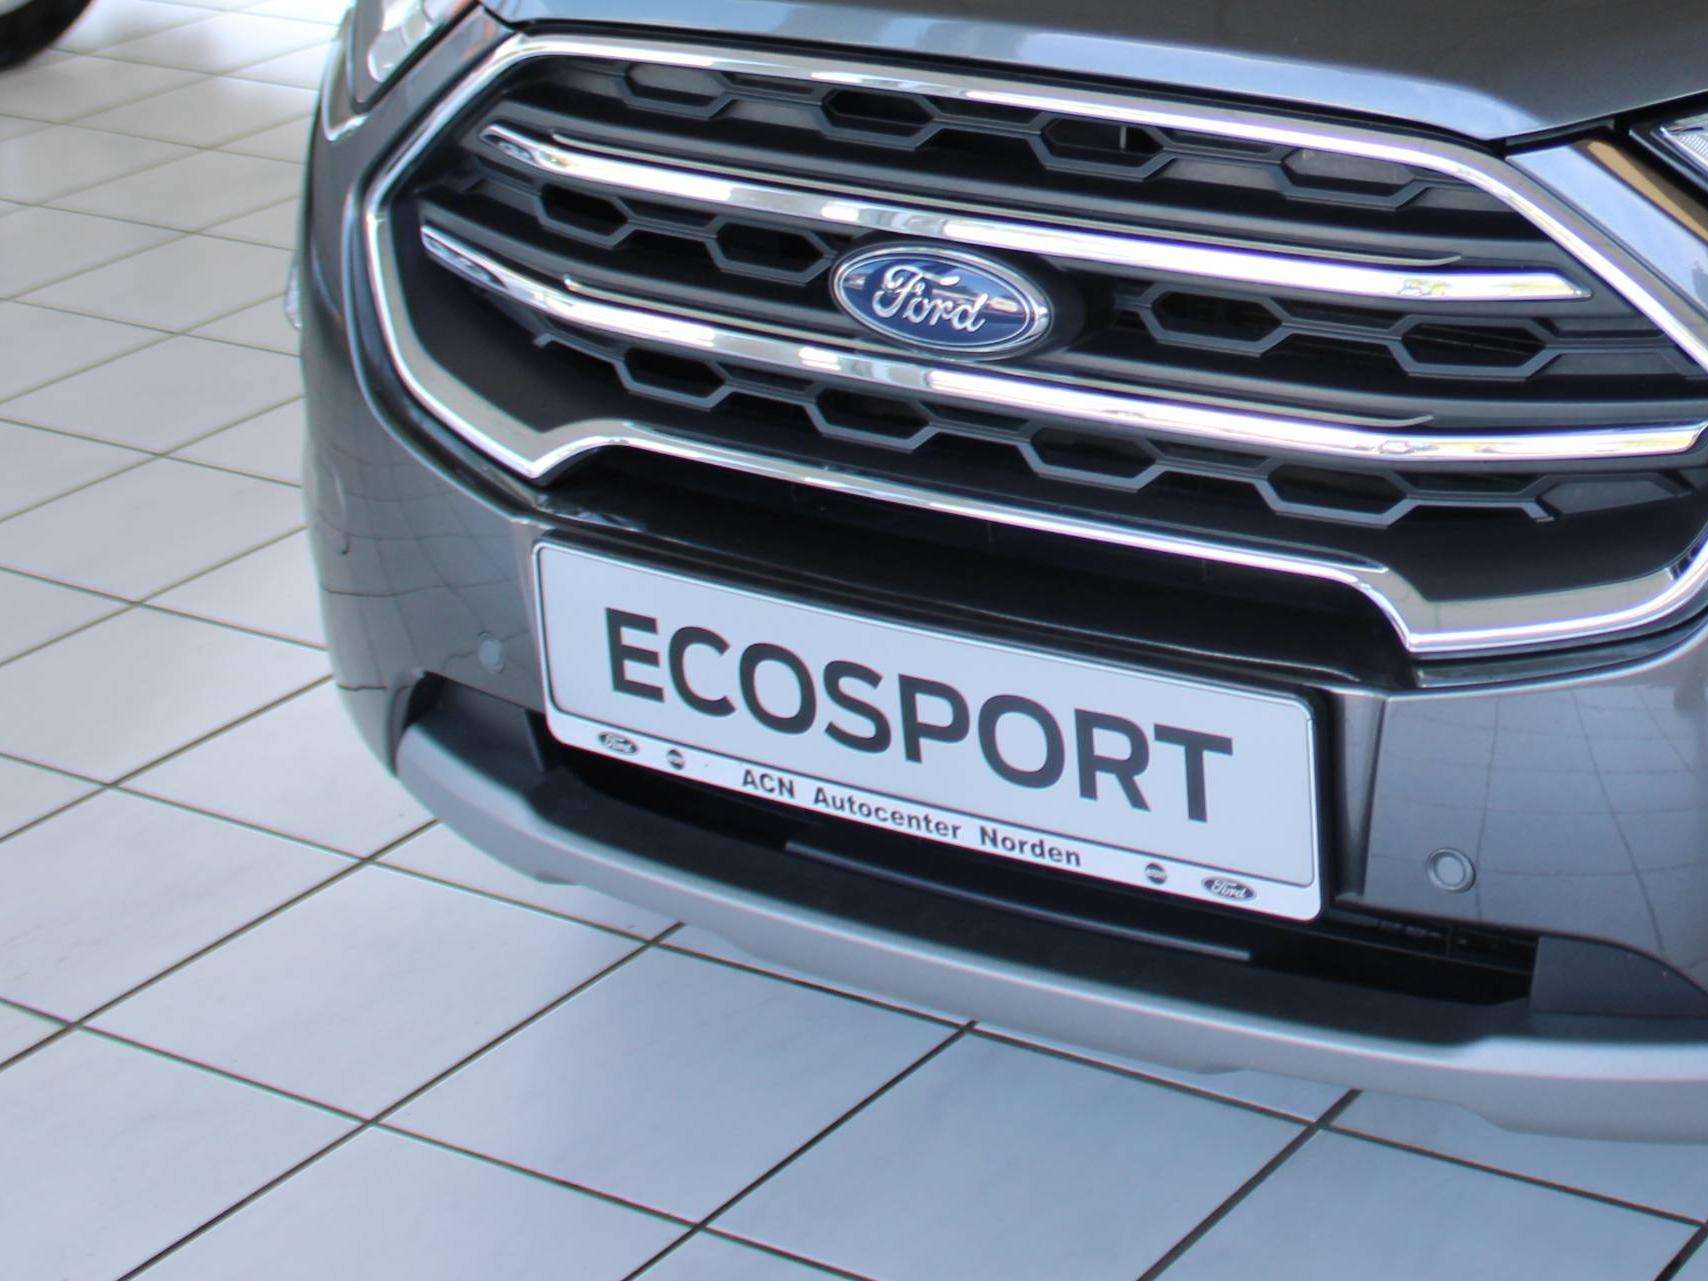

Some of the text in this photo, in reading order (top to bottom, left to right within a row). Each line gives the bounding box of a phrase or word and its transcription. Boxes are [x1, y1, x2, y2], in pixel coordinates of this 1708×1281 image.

[872, 264, 988, 333] Ford
[604, 607, 1234, 824] ECOSPORT
[742, 770, 1082, 866] ACN Autocenter Norden
[1208, 878, 1251, 900] Ford
